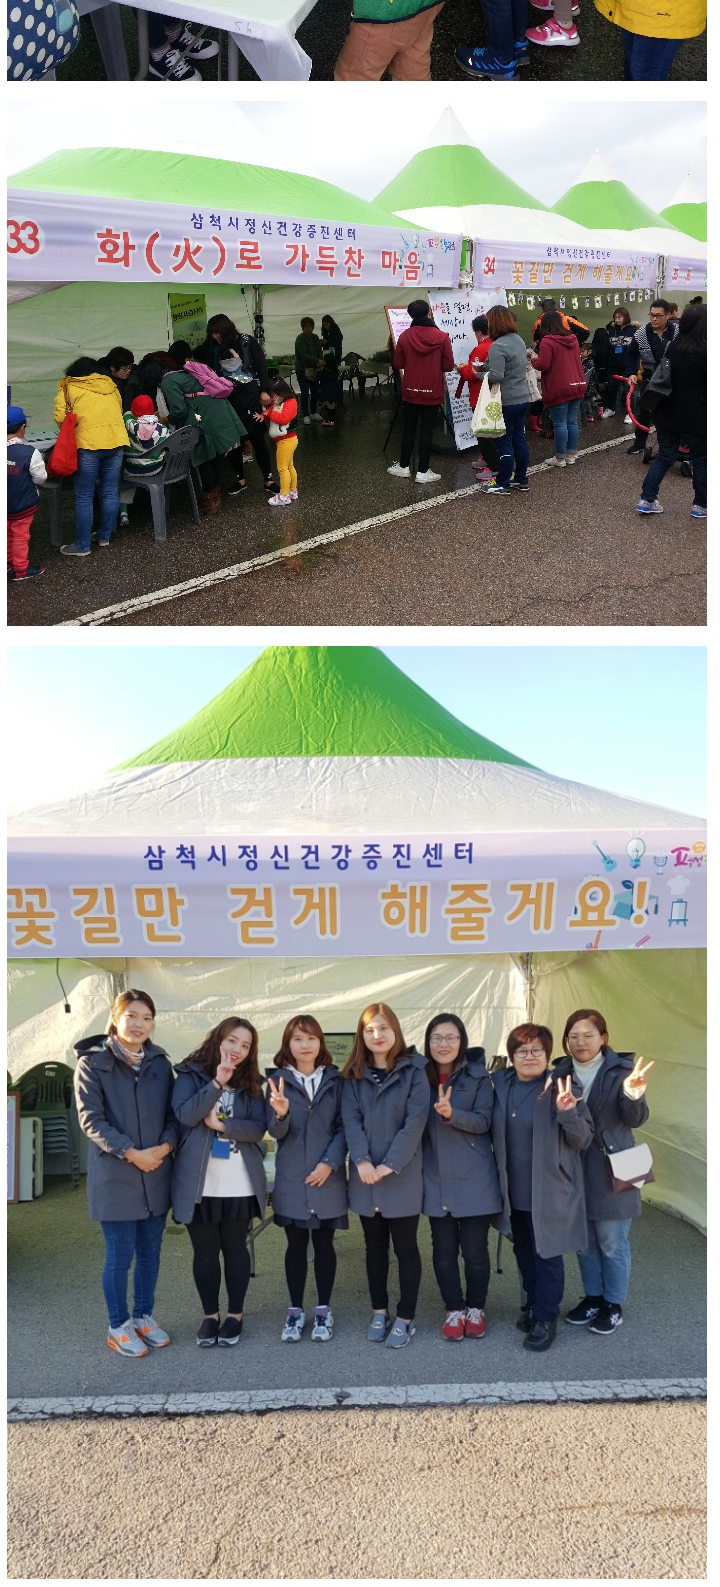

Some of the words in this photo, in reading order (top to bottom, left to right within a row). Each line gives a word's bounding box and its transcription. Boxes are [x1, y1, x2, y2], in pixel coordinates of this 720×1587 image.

[190, 213, 356, 241] 삼척시정신건강증진센터
[7, 219, 41, 255] 33
[285, 244, 365, 278] 가득찬
[381, 250, 422, 281] 마음
[483, 257, 496, 275] 34
[511, 261, 554, 285] 꽃길만
[563, 262, 588, 284] 걷게
[143, 842, 474, 871] 삼척시정신건강증진센터
[7, 887, 186, 946] 꽃길만
[230, 886, 338, 945] 걷게
[380, 880, 648, 941] 해줄게요!
